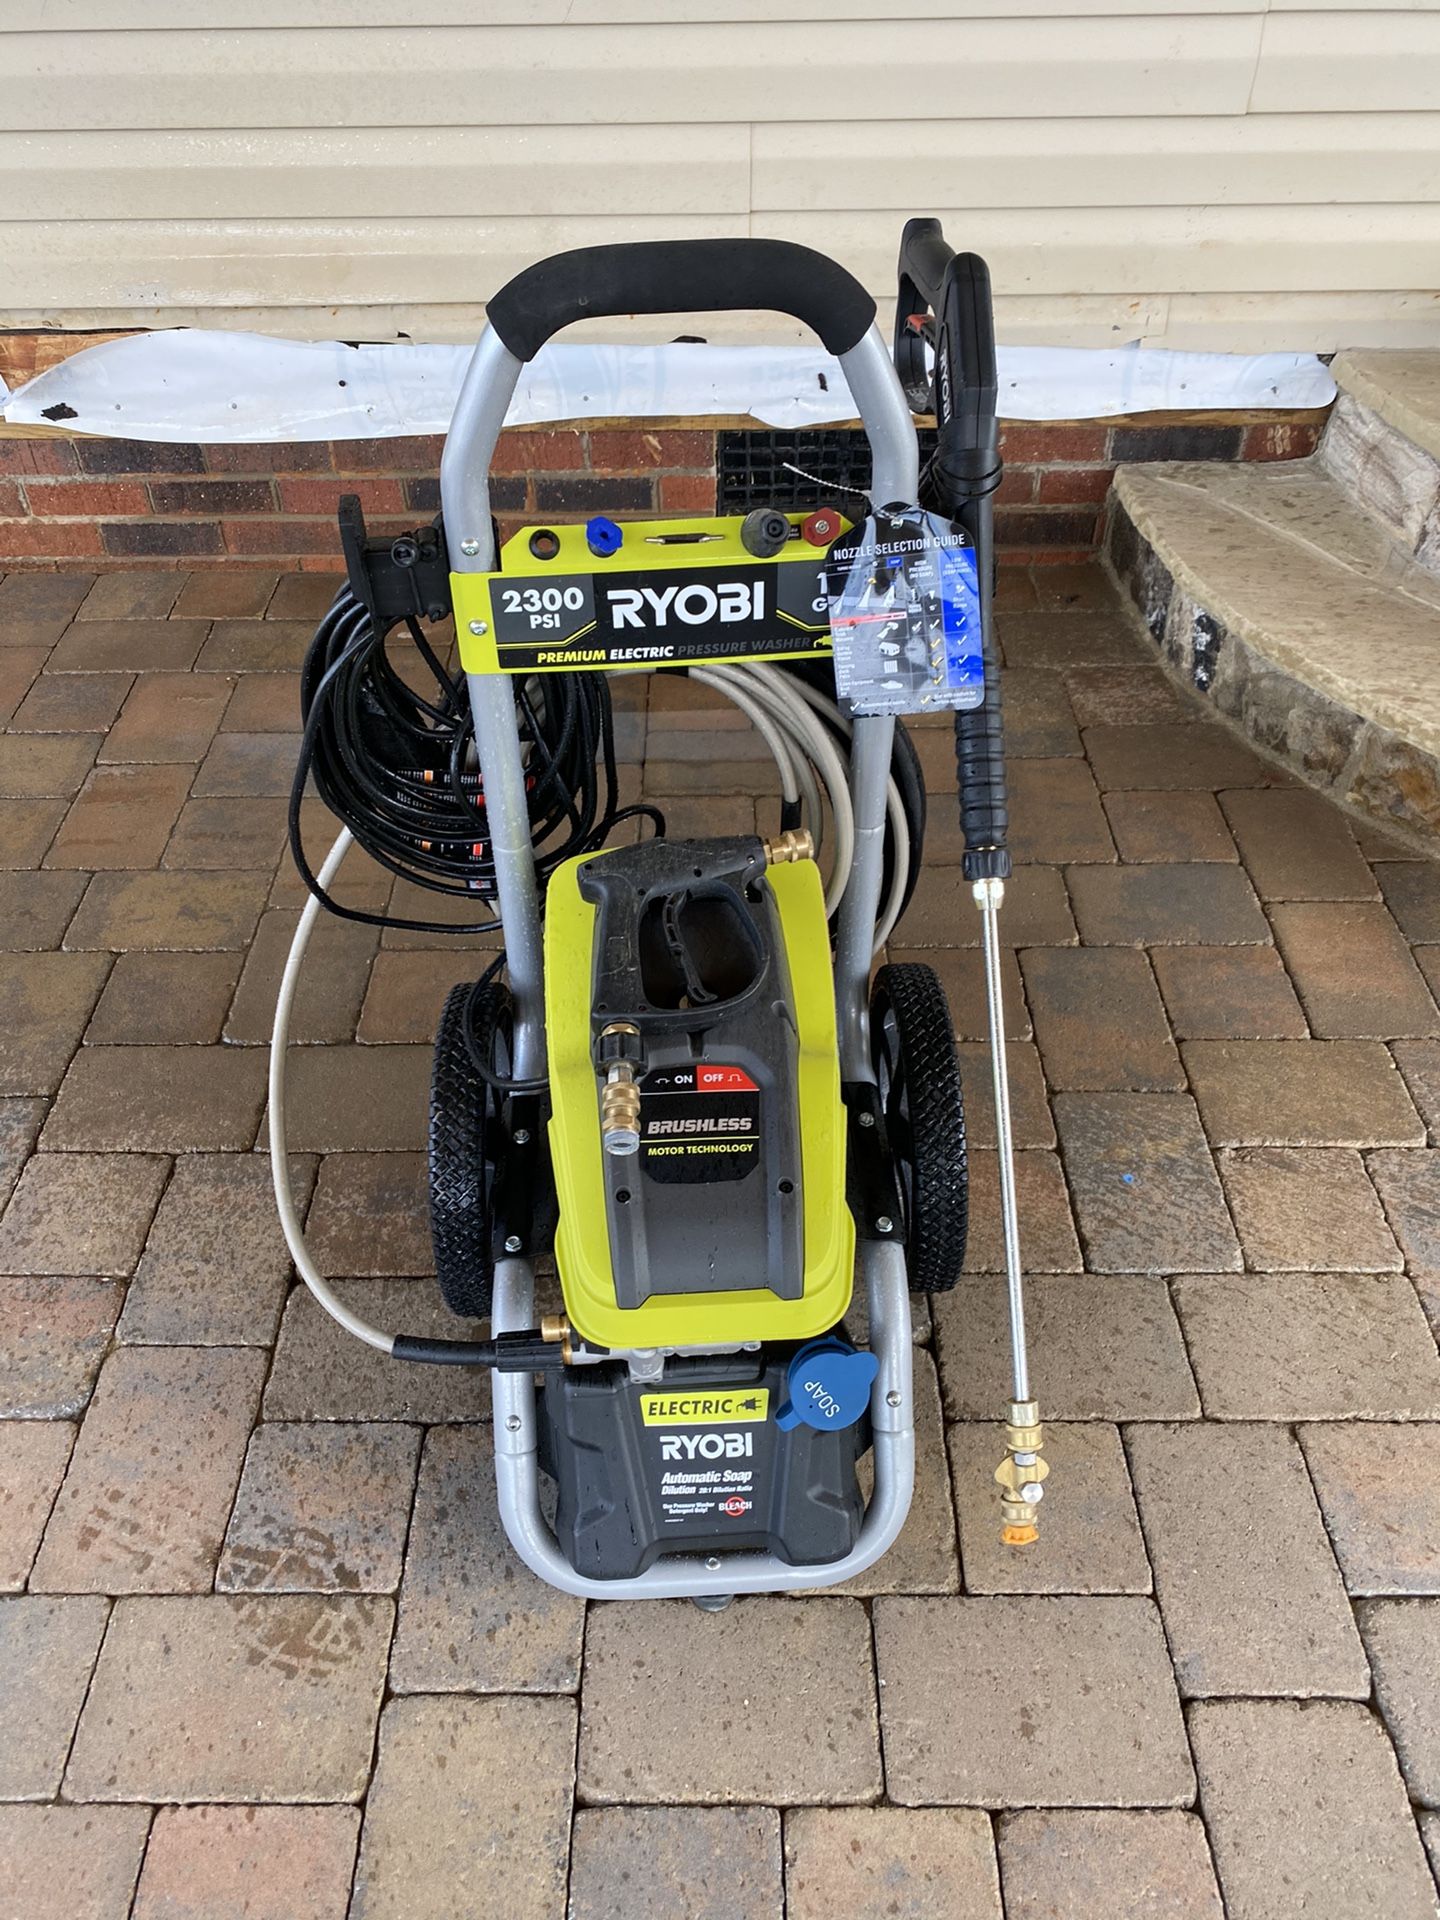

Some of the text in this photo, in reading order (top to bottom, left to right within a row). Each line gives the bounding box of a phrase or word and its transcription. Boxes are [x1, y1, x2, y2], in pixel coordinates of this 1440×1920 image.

[833, 533, 965, 560] NOZZLE SELECTION GUIDE
[501, 586, 584, 613] 2300
[607, 581, 765, 630] RYOBI
[529, 613, 561, 629] PSI
[537, 637, 810, 664] PREMIUM ELECTRIC PRESSURE WASHER
[674, 1075, 693, 1084] ON
[703, 1073, 724, 1083] OFF
[647, 1117, 753, 1135] BRUSHLESS
[647, 1143, 754, 1156] MOTOR TECHNOLOGY
[648, 1398, 733, 1416] ELECTRIC
[804, 1381, 841, 1418] SOAP
[660, 1432, 753, 1460] RYOBI
[661, 1469, 753, 1485] Automatic Soap
[661, 1485, 697, 1496] Dilution
[718, 1501, 752, 1512] BLEACH
